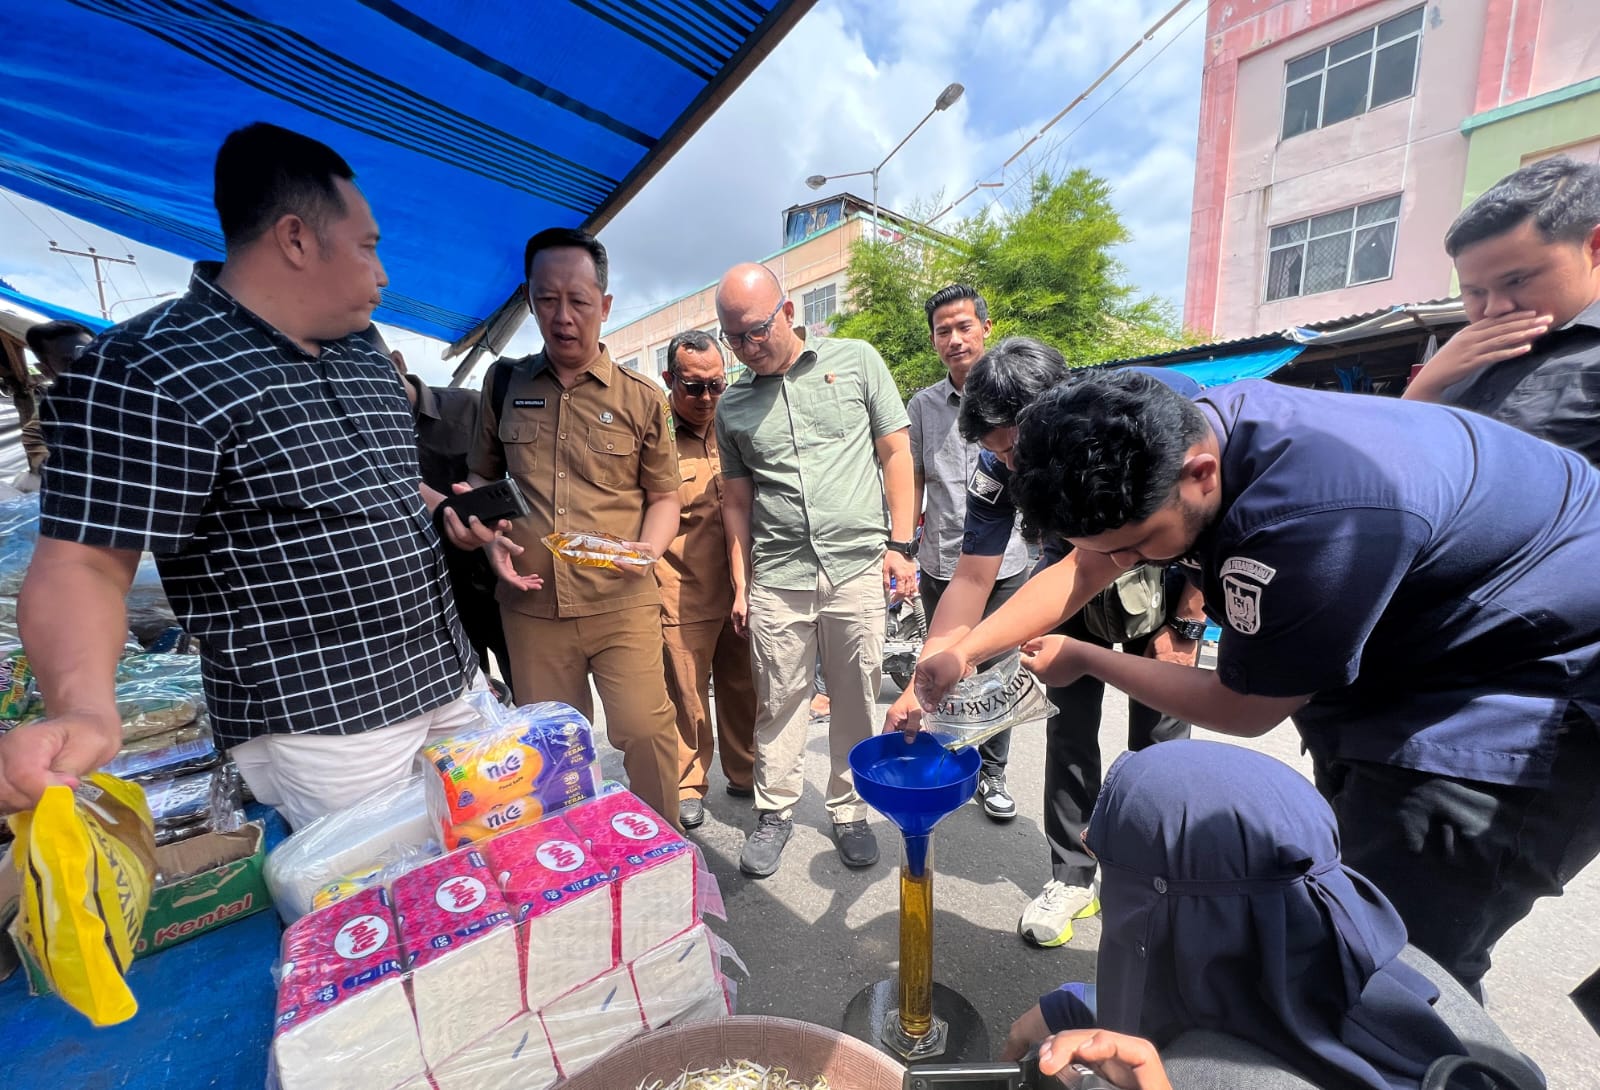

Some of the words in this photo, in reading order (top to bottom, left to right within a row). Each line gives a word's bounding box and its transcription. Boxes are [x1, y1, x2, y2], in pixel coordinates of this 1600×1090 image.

[615, 814, 653, 836] jolly
[540, 842, 577, 868] jolly
[440, 878, 478, 908] jolly
[155, 893, 253, 946] Kental
[341, 917, 380, 954] jolly
